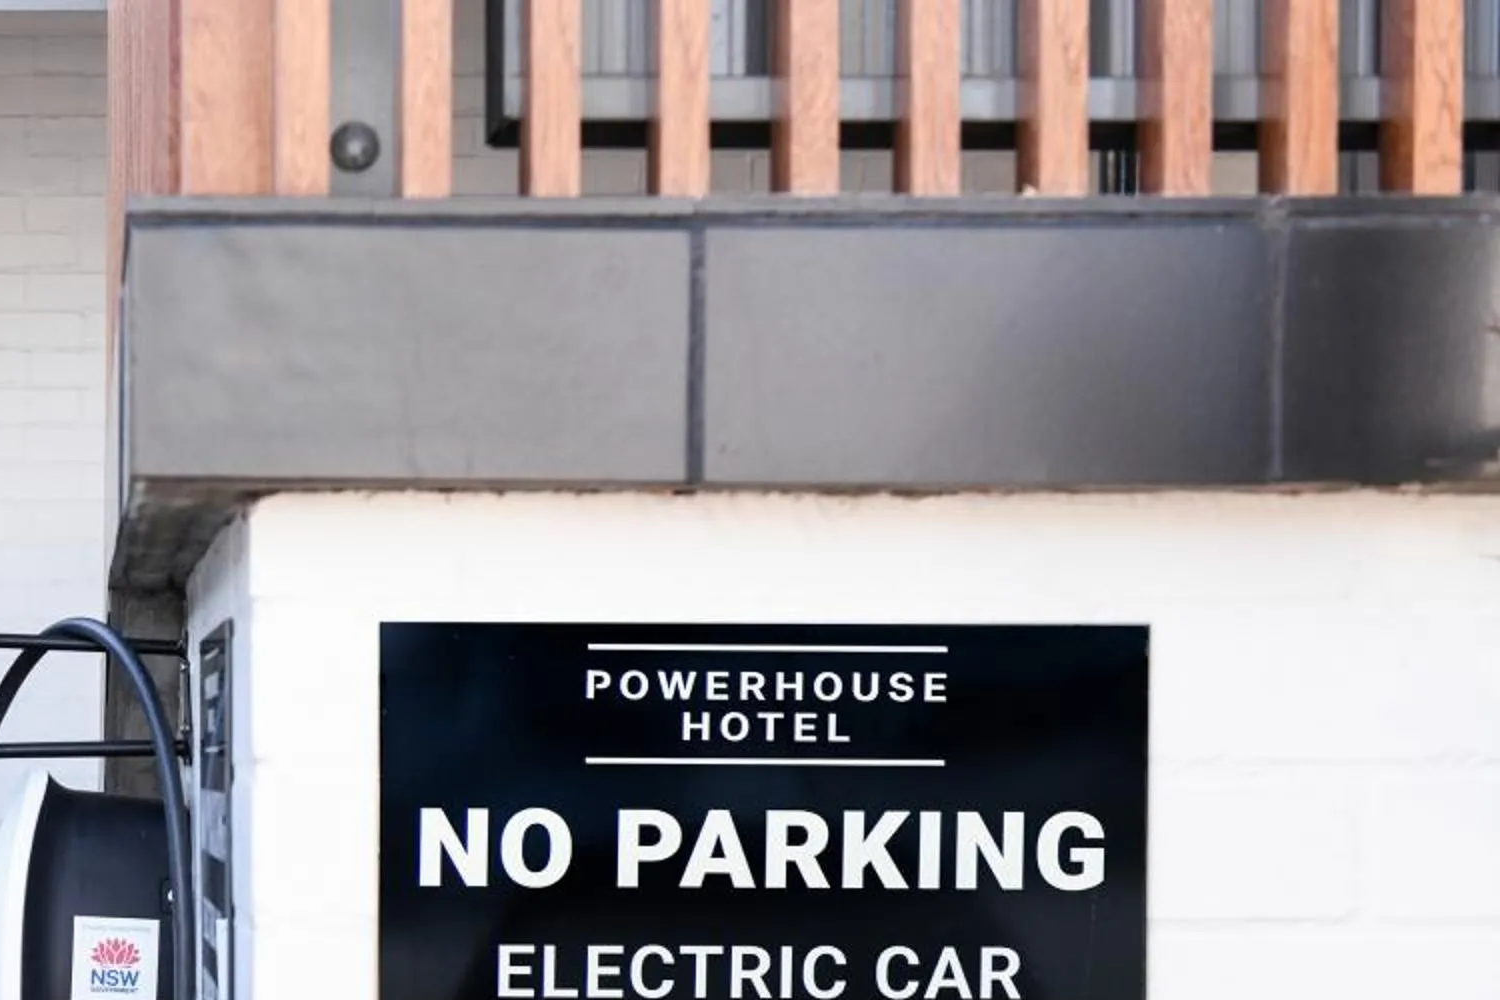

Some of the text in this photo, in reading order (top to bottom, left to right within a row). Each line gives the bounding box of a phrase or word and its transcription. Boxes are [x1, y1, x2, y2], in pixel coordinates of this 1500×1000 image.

[585, 669, 948, 702] POWERHOUSE
[682, 711, 851, 742] HOTEL
[419, 807, 1106, 892] NO PARKING
[91, 969, 139, 986] NSW
[497, 944, 1021, 1000] ELECTRIC CAR
